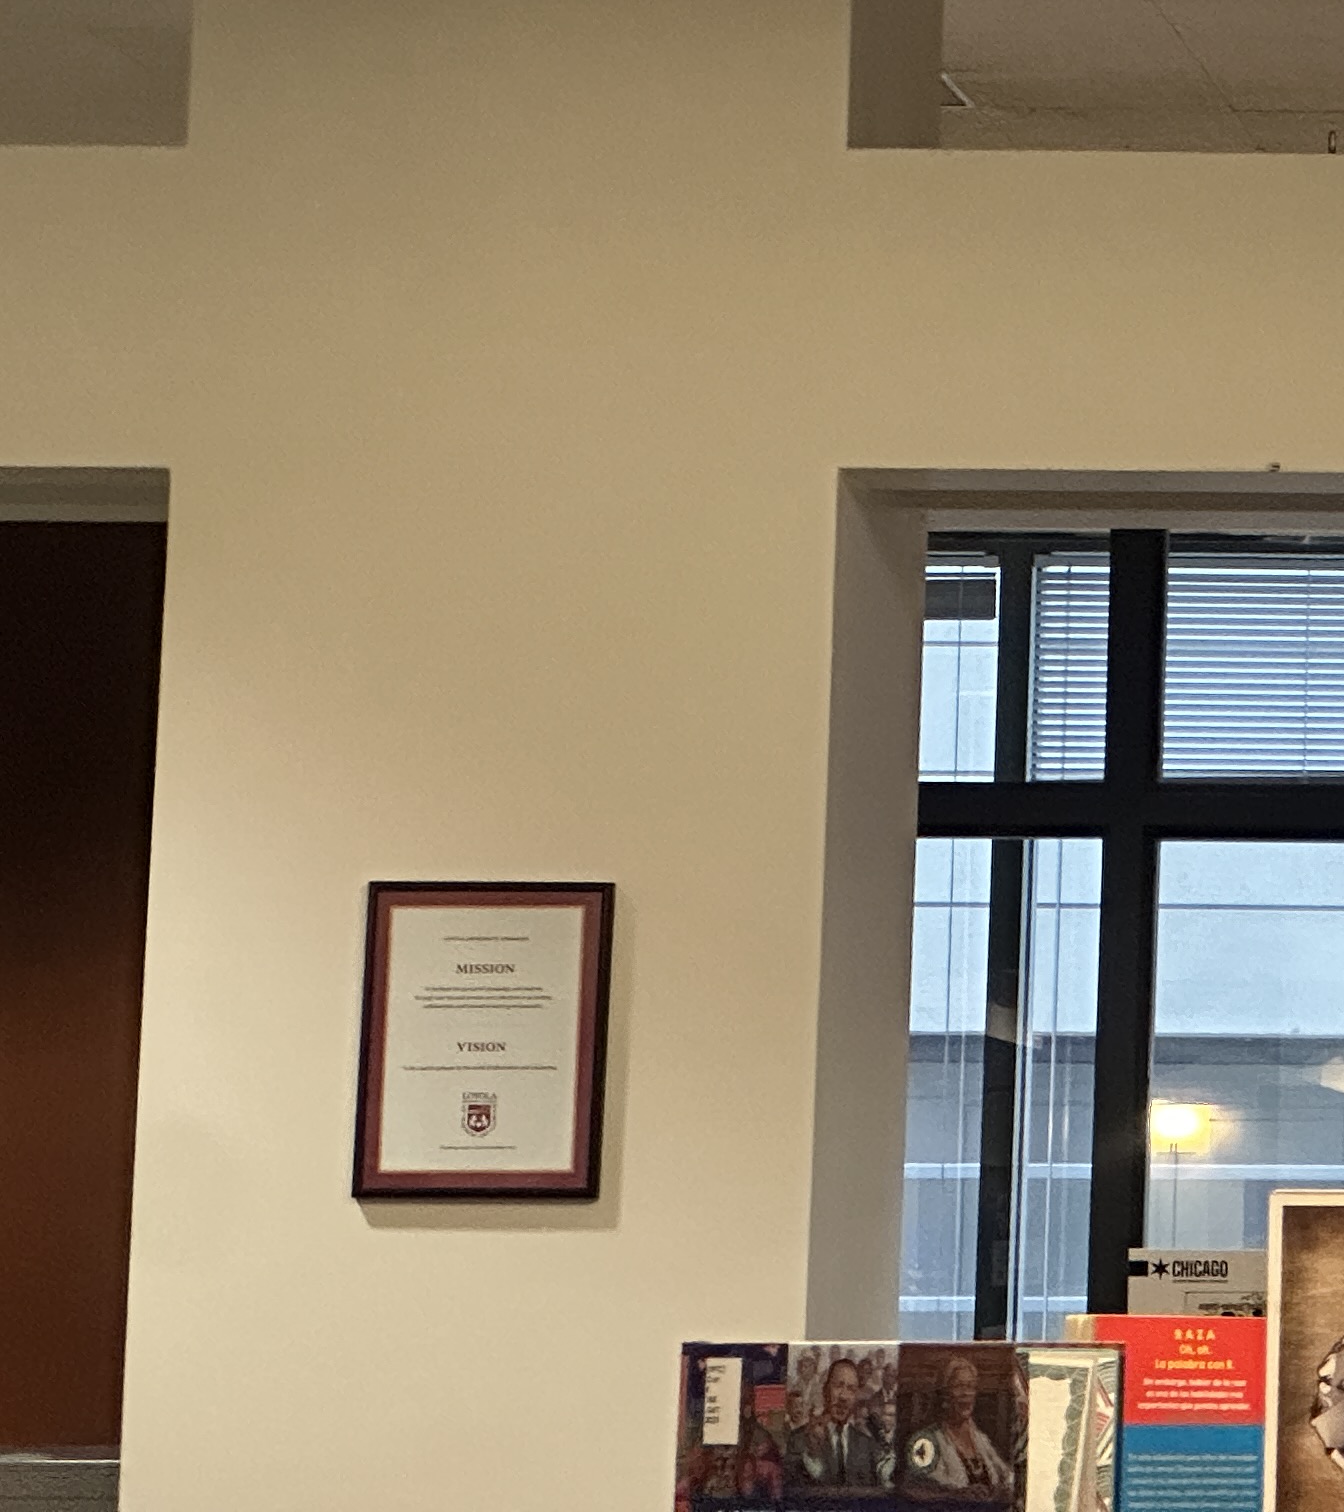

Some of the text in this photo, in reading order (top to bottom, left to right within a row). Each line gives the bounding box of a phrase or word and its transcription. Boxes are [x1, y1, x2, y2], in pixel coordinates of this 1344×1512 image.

[456, 964, 515, 974] MISSION
[456, 1042, 506, 1052] VISION
[1172, 1261, 1228, 1277] CHICAGO
